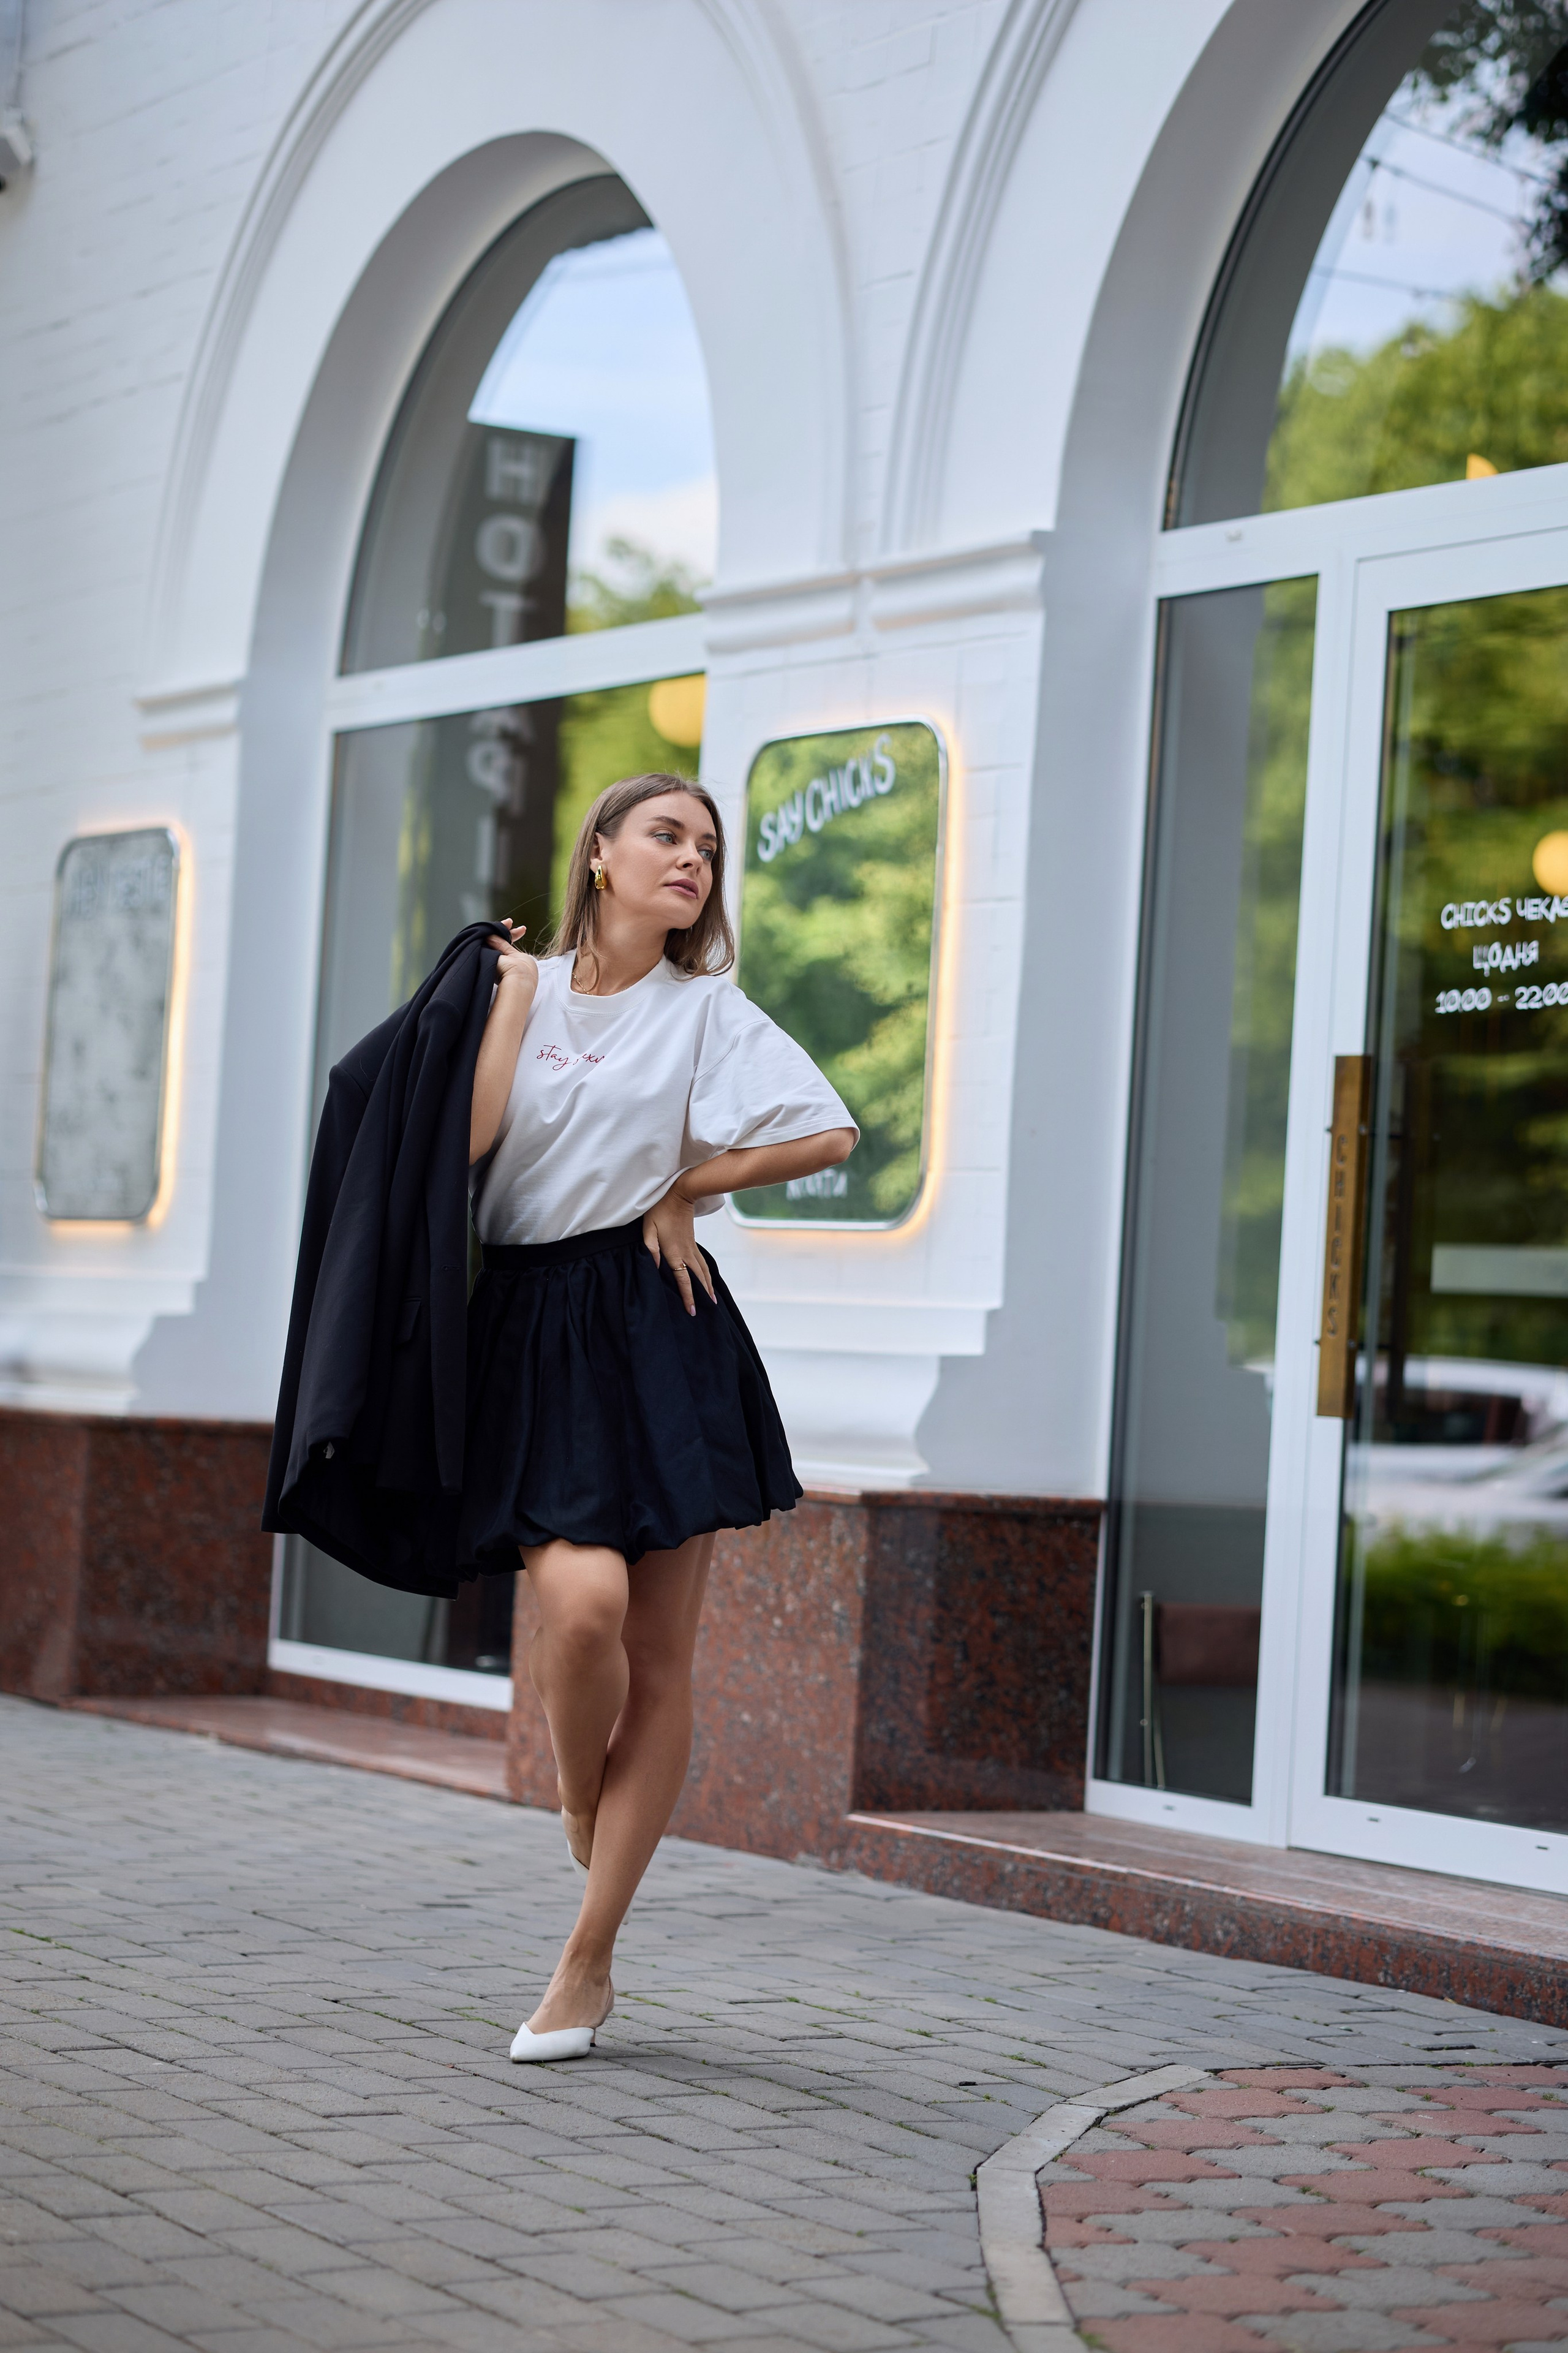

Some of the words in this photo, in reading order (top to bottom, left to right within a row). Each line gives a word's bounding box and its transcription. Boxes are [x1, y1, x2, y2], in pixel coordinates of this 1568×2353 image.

[757, 790, 804, 863] SAY
[805, 733, 896, 833] CHICKS
[1441, 897, 1512, 930] CHICKS
[1472, 940, 1539, 977] ЩОДНЯ
[537, 1045, 571, 1070] stay
[1327, 1135, 1347, 1337] CHICKS
